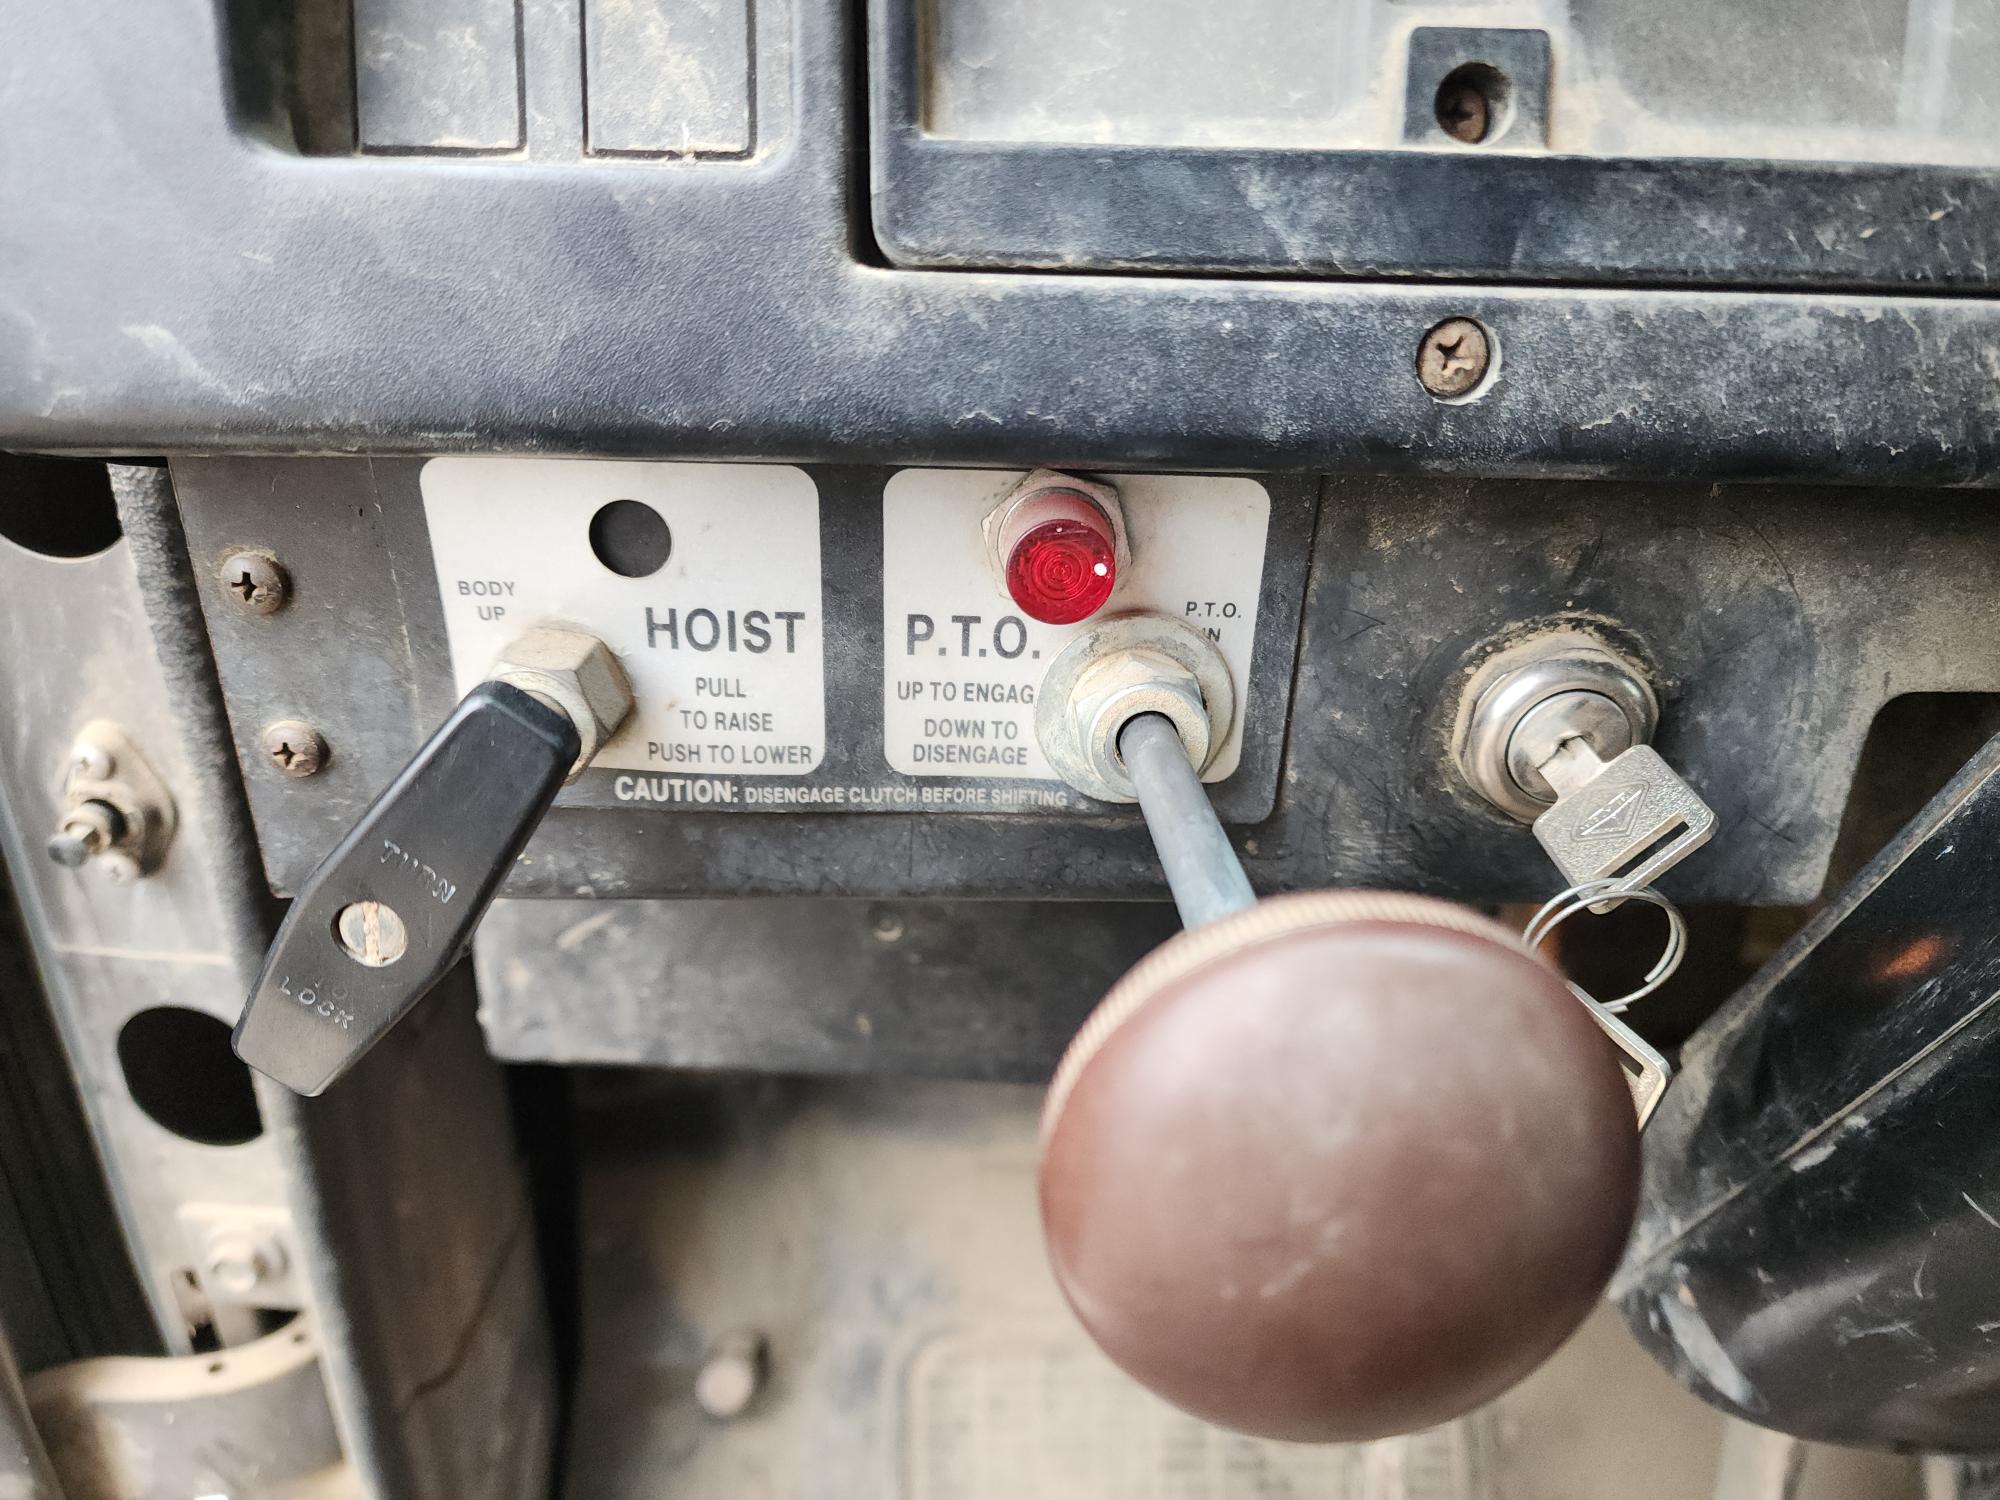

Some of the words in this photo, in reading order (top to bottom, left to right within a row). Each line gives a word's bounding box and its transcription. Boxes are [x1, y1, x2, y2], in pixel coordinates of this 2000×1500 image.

[458, 580, 516, 597] BODY
[477, 605, 506, 622] UP
[1184, 600, 1242, 619] P.T.O.
[645, 606, 806, 654] HOIST
[905, 612, 1041, 660] P.T.O.
[695, 676, 747, 698] PULL
[897, 680, 923, 701] UP
[929, 681, 957, 701] TO
[963, 682, 1034, 705] ENGAG
[680, 709, 712, 732] TO
[715, 710, 773, 733] RAISE
[924, 718, 986, 740] DOWN
[991, 720, 1018, 741] TO
[648, 740, 703, 764] PUSH
[707, 743, 738, 764] TO
[742, 744, 813, 766] LOWER
[913, 744, 1028, 766] DISENGAGE
[614, 775, 739, 804] CAUTION:
[745, 786, 845, 804] DISENGAGE
[849, 787, 917, 804] CLUTCH
[922, 787, 987, 805] BEFORE
[991, 788, 1069, 807] SHIFTING
[279, 975, 355, 1030] LOCK
